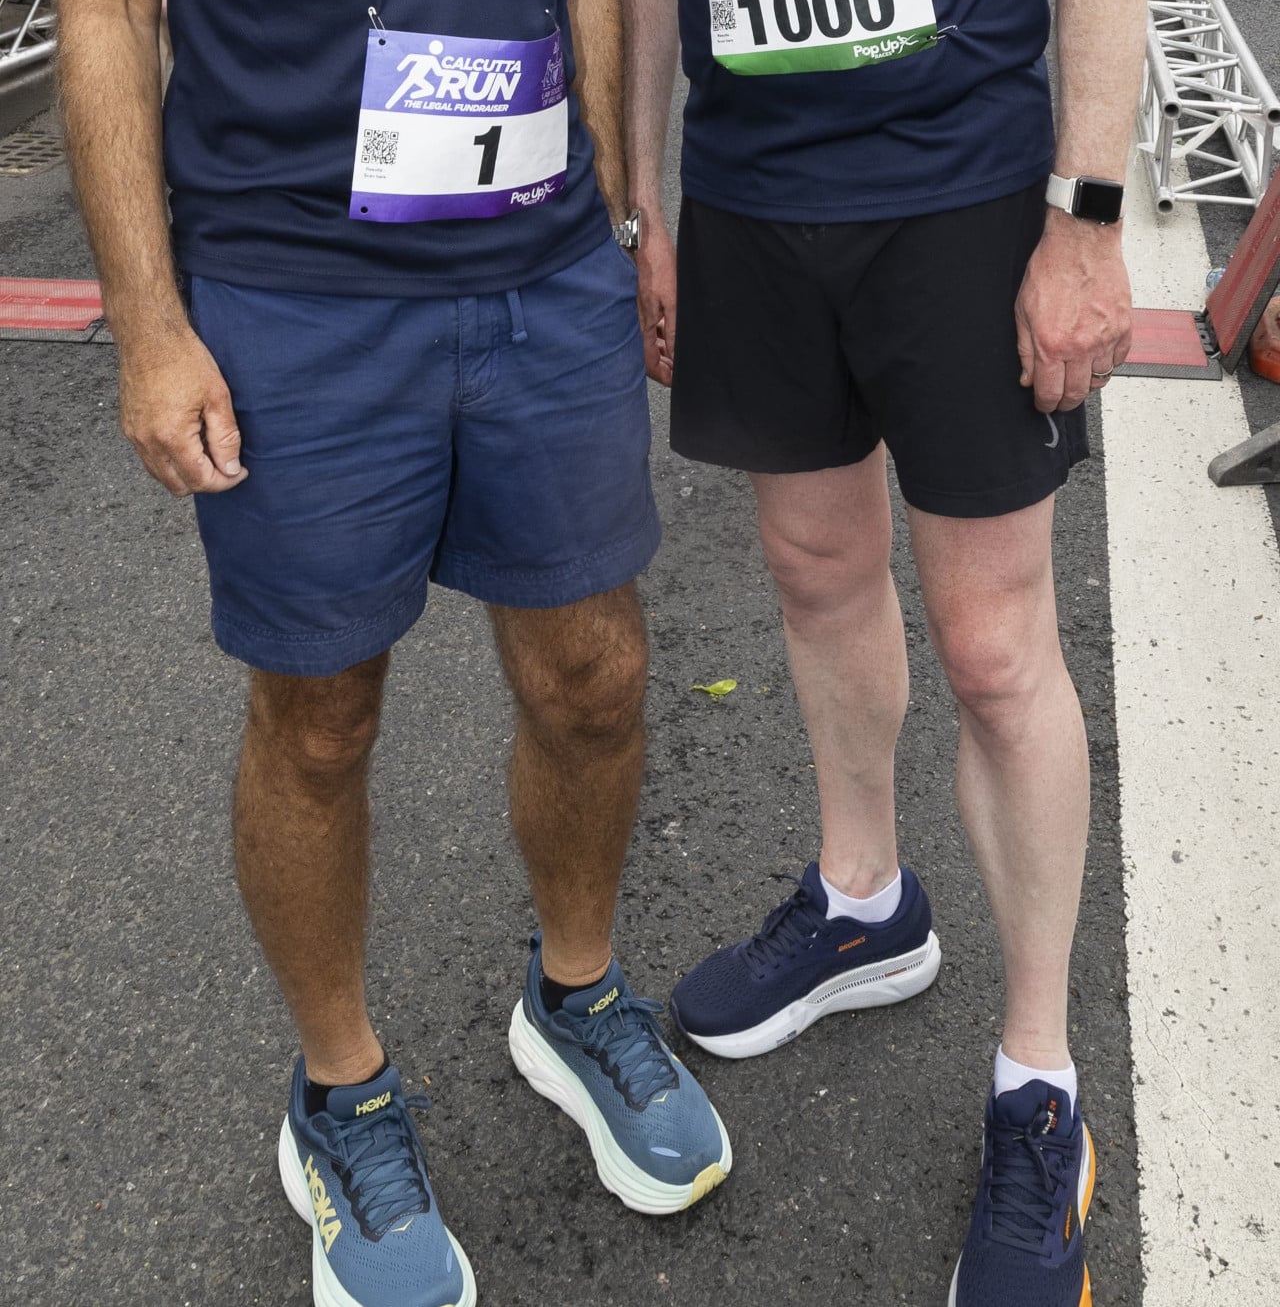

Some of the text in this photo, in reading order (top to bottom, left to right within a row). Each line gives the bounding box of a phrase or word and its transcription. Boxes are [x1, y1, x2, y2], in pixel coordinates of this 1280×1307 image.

[852, 38, 900, 59] Pop Up
[440, 55, 522, 73] CALCUTTA
[434, 69, 523, 102] RUN
[403, 99, 510, 113] THE LEGAL FUNDRAISER
[473, 125, 503, 186] 1
[510, 186, 545, 205] Pop Up
[588, 986, 619, 1016] HOKA
[355, 1091, 392, 1117] HOKA
[303, 1153, 343, 1255] HOKA
